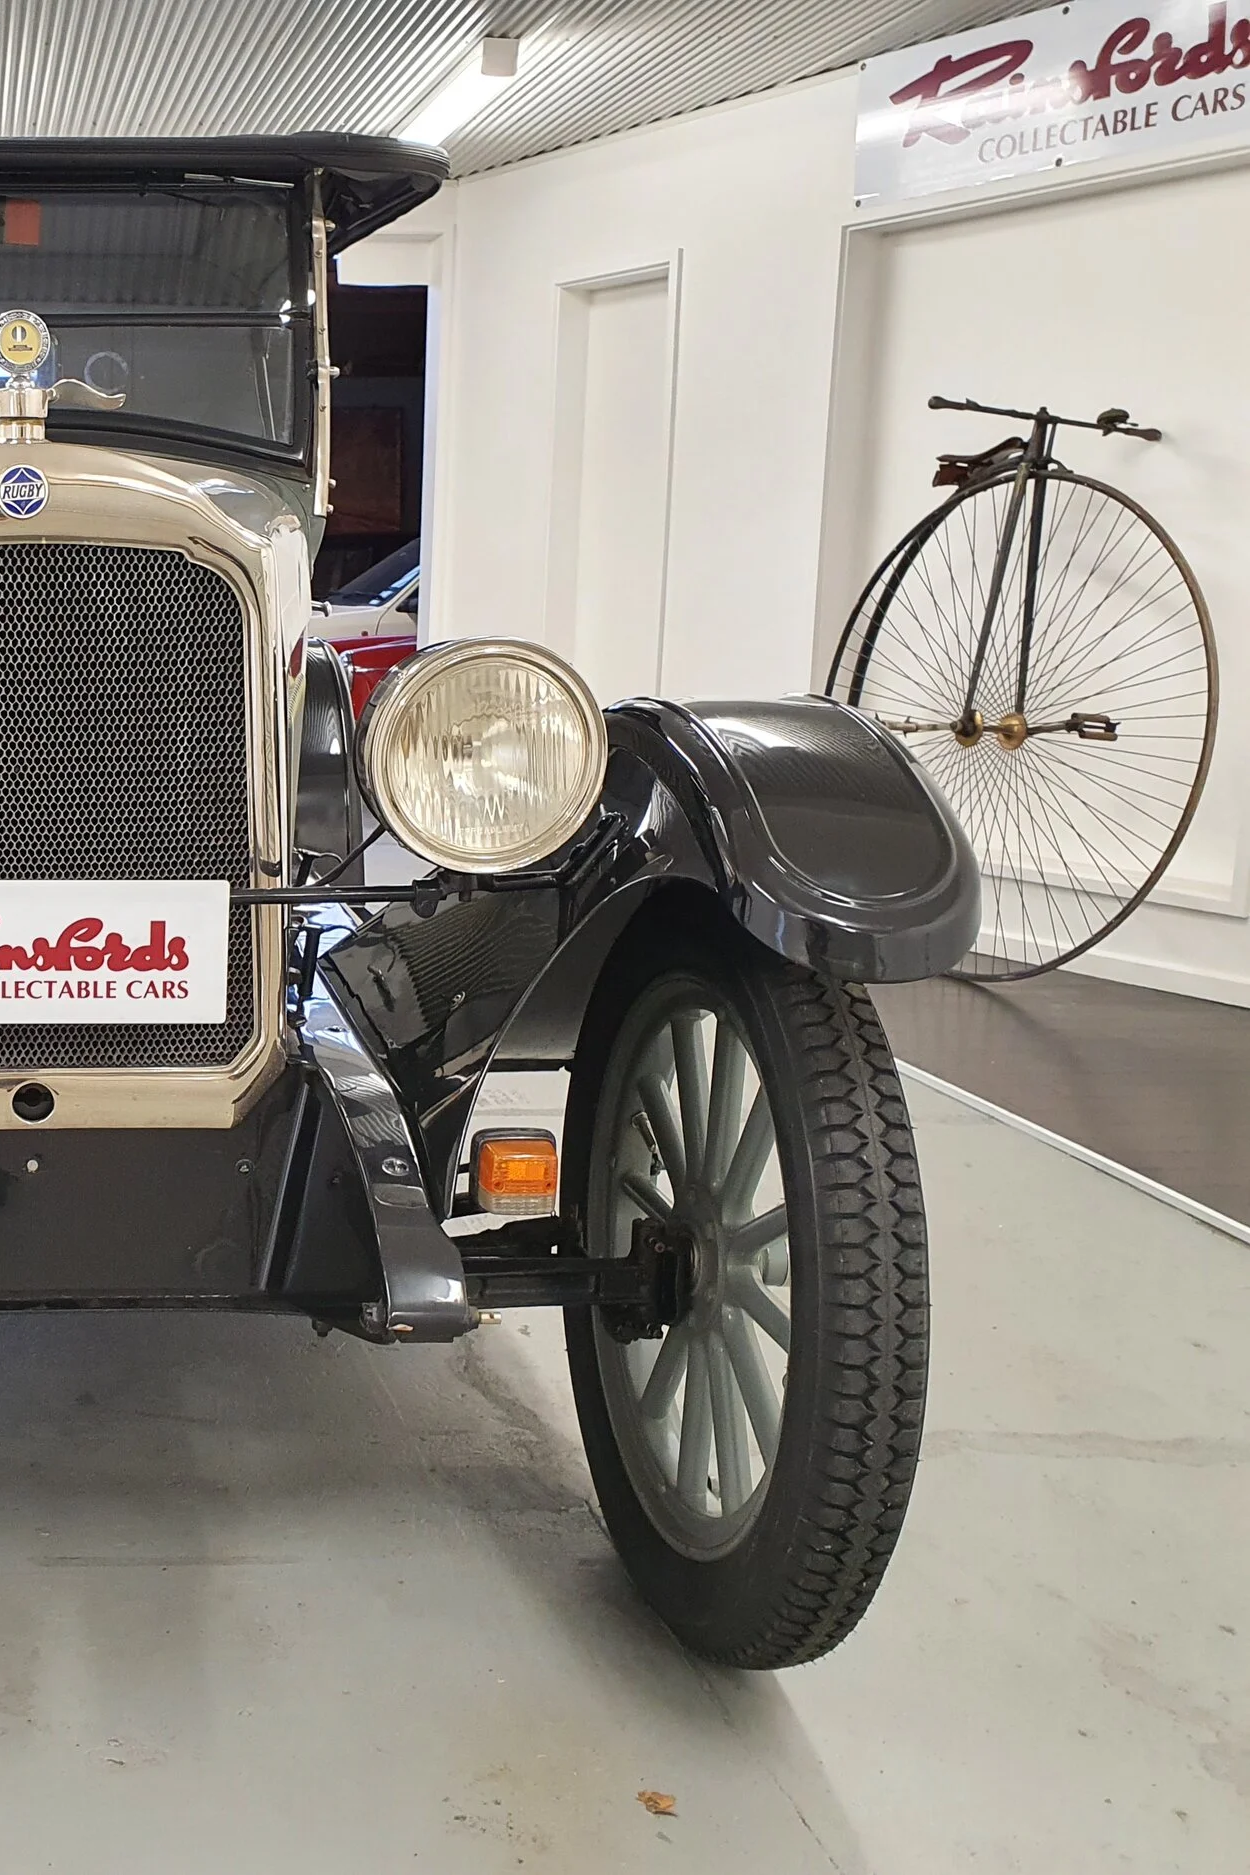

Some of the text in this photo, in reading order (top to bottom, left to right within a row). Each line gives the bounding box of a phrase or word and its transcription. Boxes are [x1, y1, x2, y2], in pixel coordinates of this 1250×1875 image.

[978, 83, 1246, 164] COLLECTABLE CARS
[2, 483, 44, 499] RUGBY
[126, 980, 189, 999] CARS
